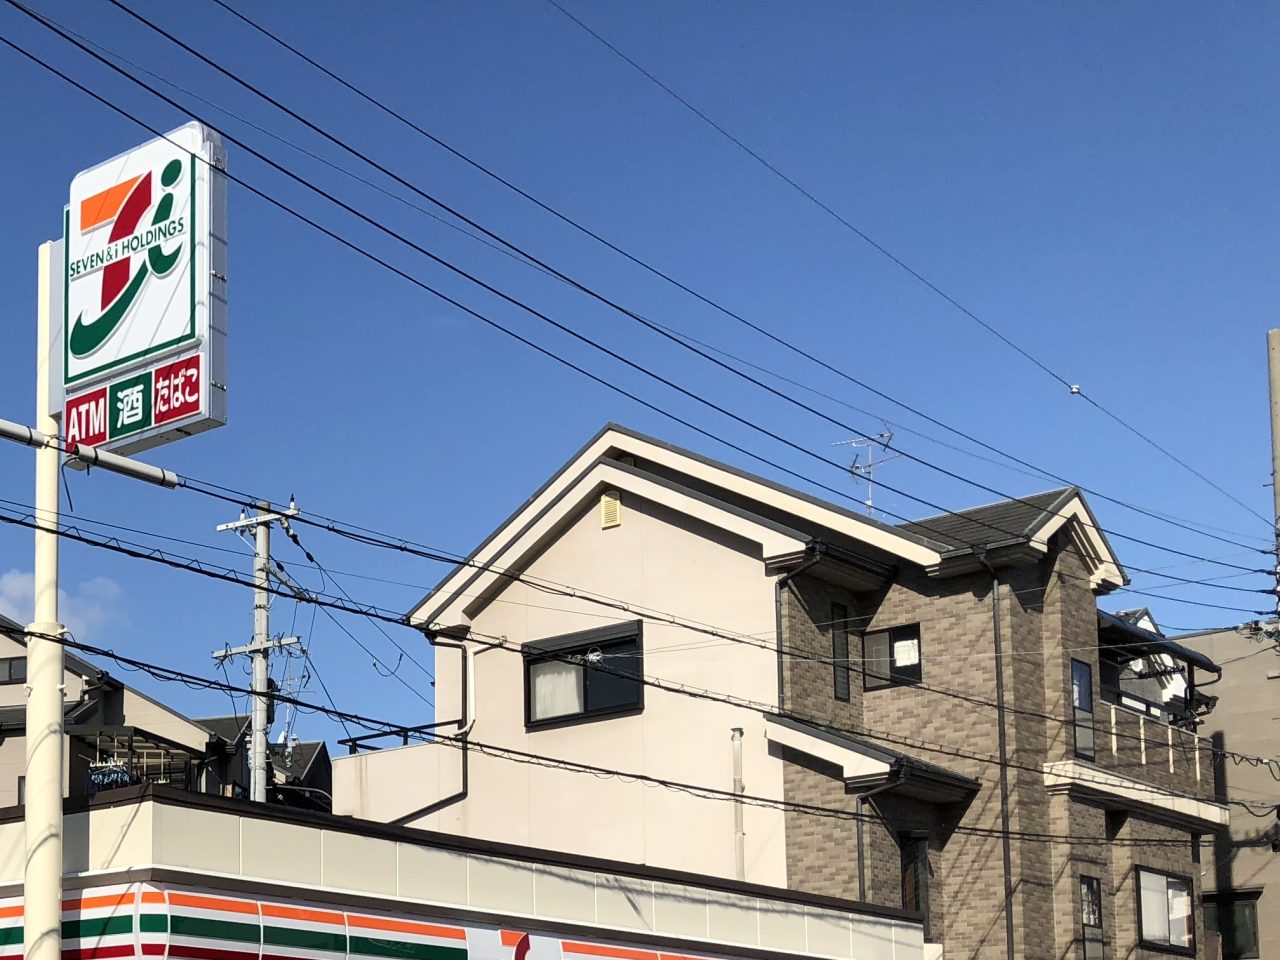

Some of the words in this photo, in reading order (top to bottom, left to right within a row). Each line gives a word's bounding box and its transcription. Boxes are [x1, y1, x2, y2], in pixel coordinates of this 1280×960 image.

[121, 216, 185, 255] HOLDINGS
[67, 396, 106, 445] ATM
[116, 383, 144, 429] 酒
[155, 367, 199, 416] たばこ
